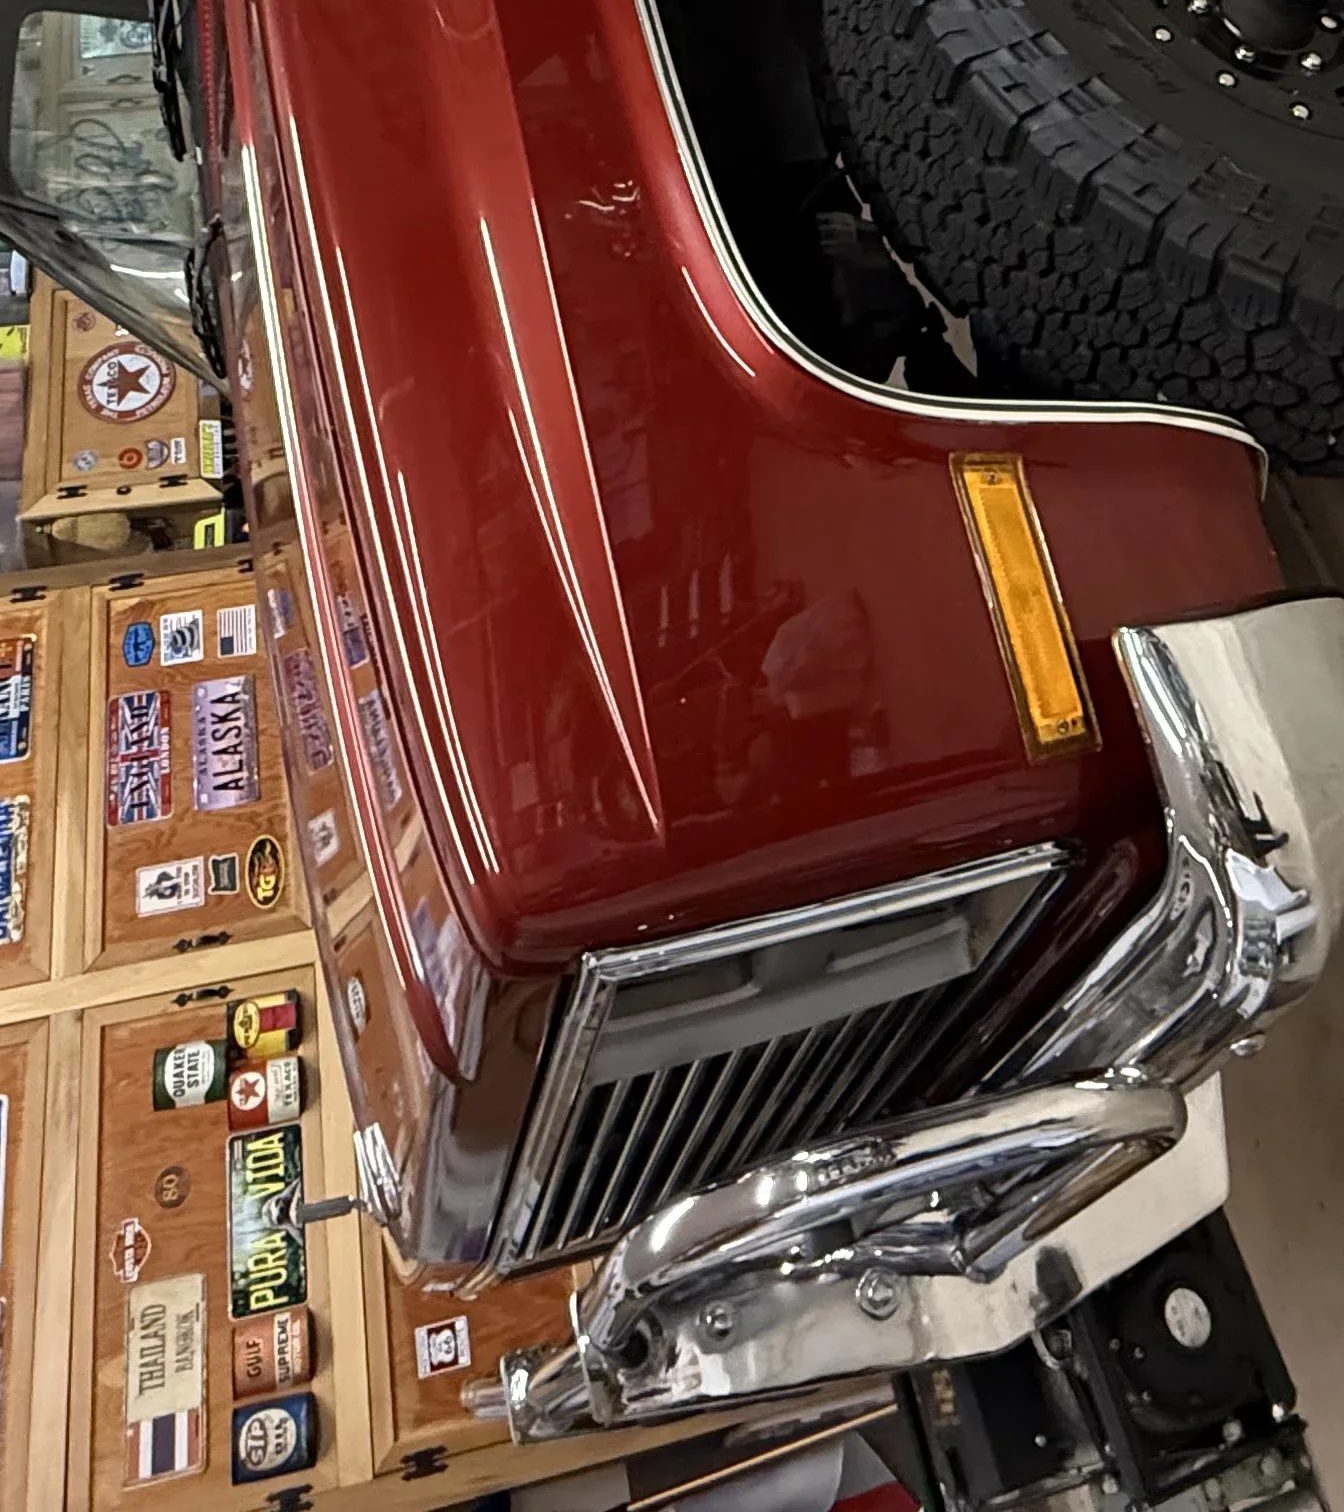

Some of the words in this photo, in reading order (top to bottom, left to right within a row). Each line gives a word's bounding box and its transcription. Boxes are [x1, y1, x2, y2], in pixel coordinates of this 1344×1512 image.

[159, 726, 170, 774] LONDON
[209, 691, 245, 792] ALASKA
[172, 1048, 186, 1098] QUAKER
[187, 1050, 200, 1089] STATE
[162, 1174, 179, 1201] 80
[245, 1131, 285, 1200] VIDA
[248, 1231, 290, 1309] PURA
[138, 1303, 166, 1394] THAILAND
[174, 1309, 195, 1372] BANGKOK
[245, 1340, 262, 1378] GULF
[276, 1318, 290, 1383] SUPREME
[246, 1420, 266, 1464] STP
